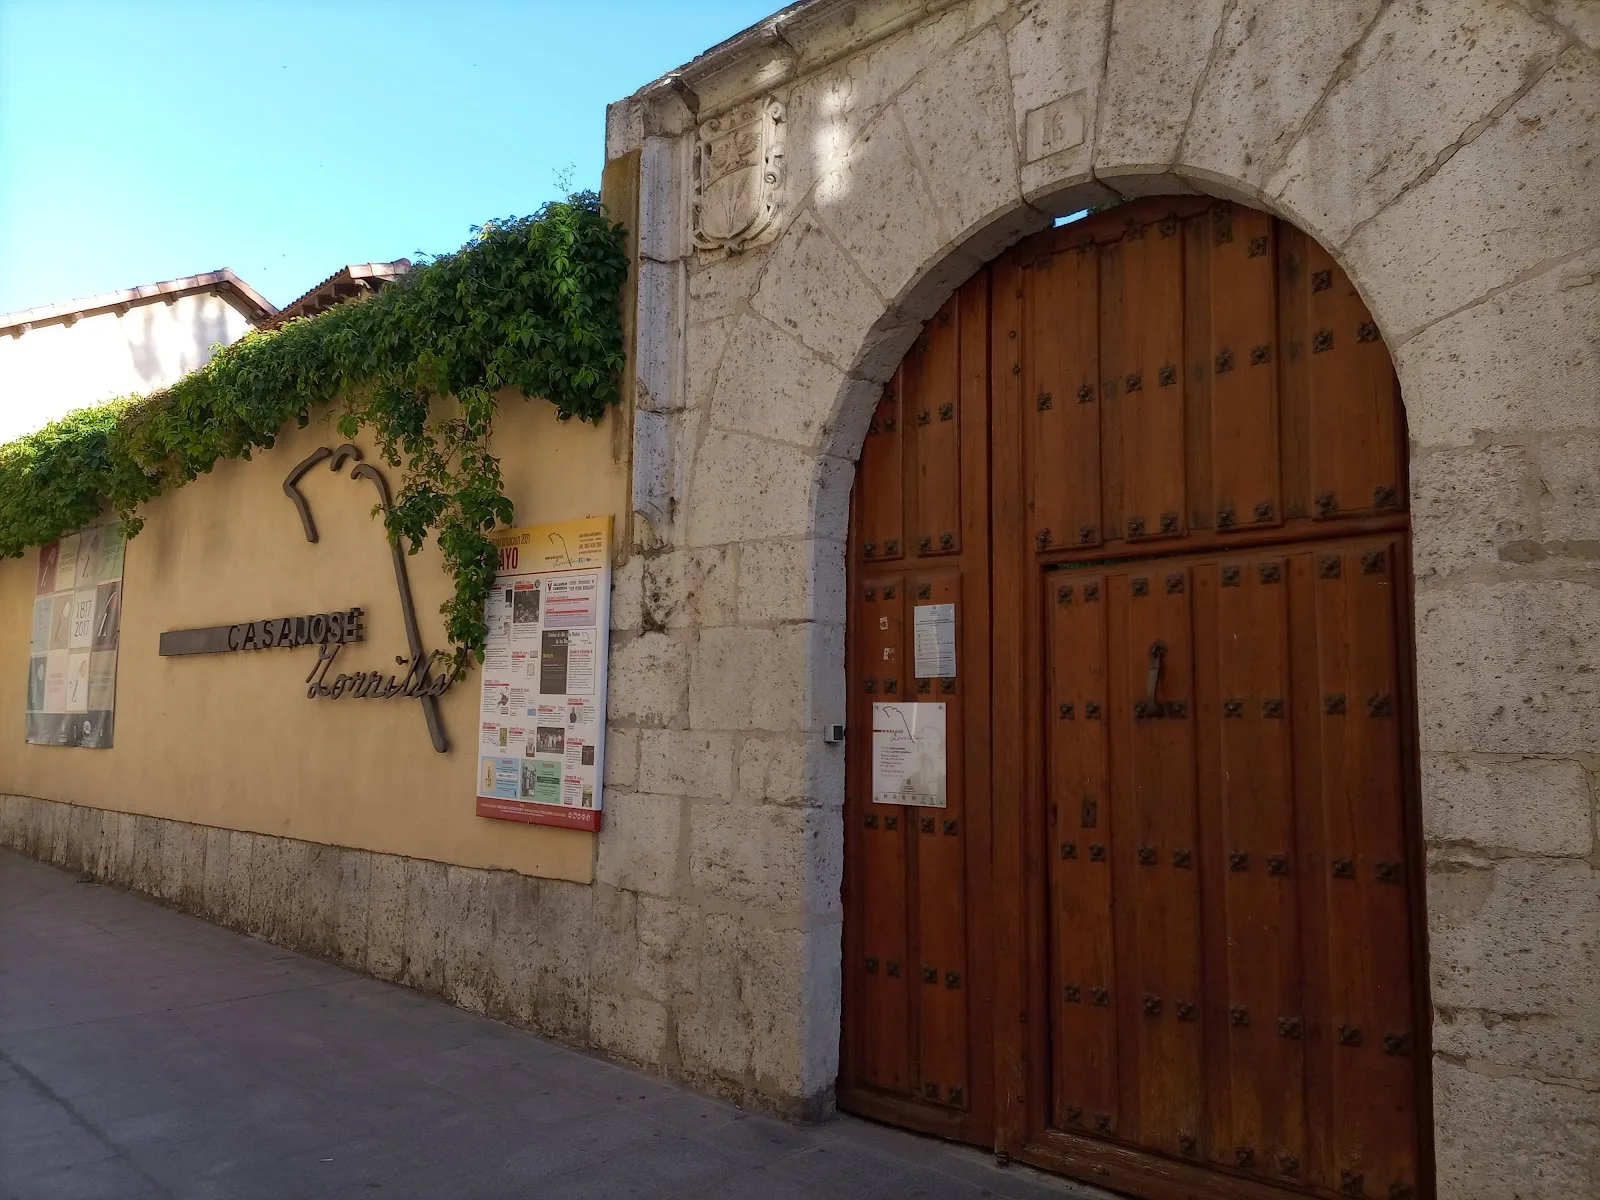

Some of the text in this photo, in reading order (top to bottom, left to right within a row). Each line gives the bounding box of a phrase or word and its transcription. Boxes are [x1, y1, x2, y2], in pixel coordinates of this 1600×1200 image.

[495, 547, 518, 571] AYO
[76, 600, 92, 619] 1817
[74, 620, 90, 637] 2017
[306, 644, 456, 699] Zorrilla
